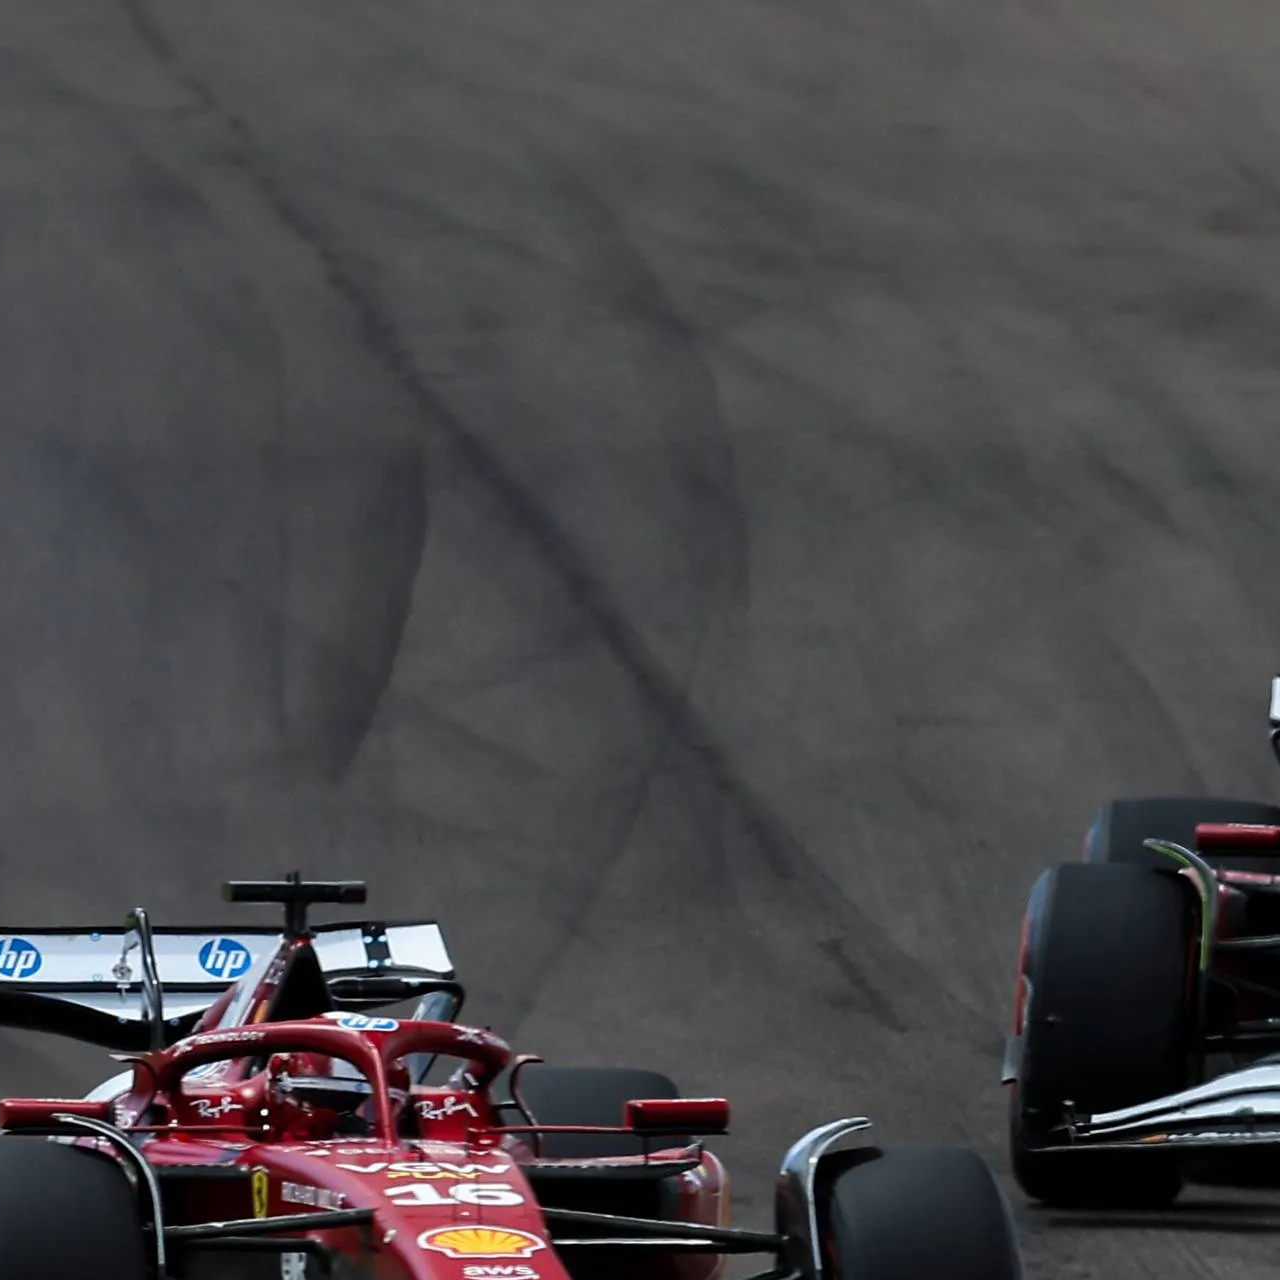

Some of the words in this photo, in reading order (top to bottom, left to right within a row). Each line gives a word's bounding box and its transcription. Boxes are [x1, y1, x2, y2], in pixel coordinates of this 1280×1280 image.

[203, 937, 248, 979] hp
[335, 1162, 510, 1174] VGW
[383, 1182, 524, 1206] 16
[463, 1264, 539, 1280] aws
